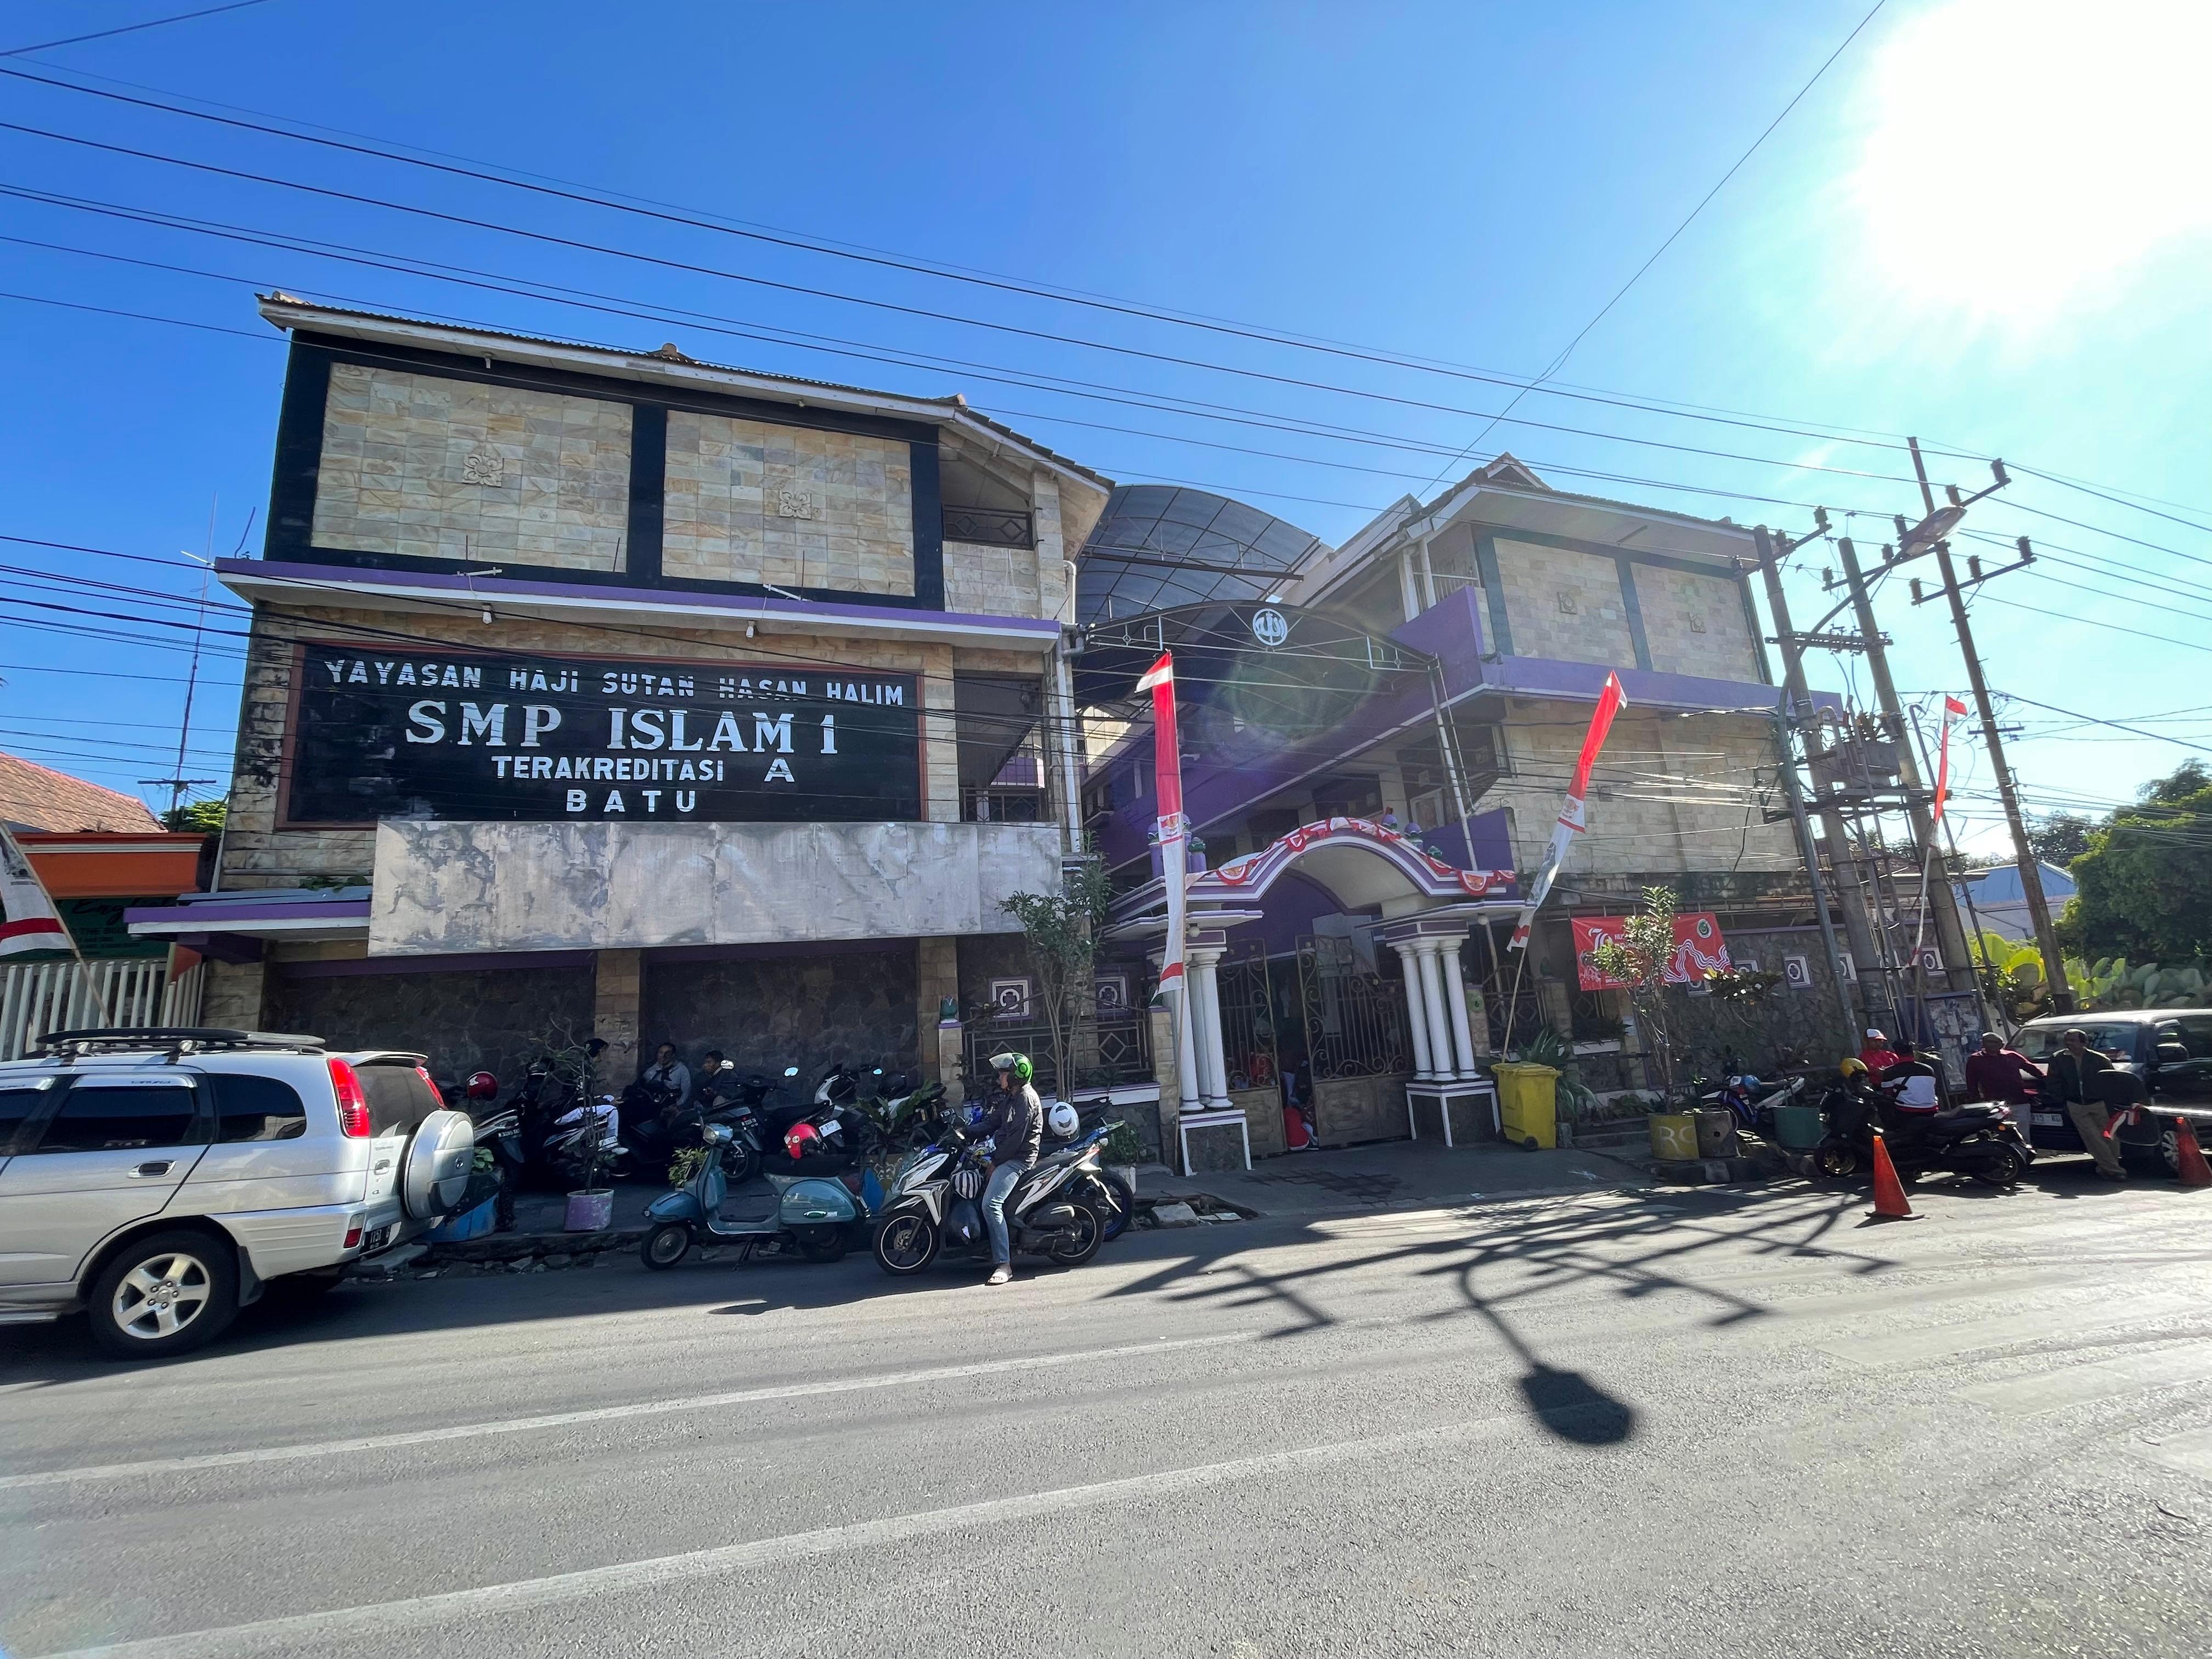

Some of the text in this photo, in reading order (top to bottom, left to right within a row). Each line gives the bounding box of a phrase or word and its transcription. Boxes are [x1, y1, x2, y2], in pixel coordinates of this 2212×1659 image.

[324, 659, 903, 706] YAYASAN HAJI SUTAN HASAN HALIM
[405, 699, 838, 754] SMP ISLAM 1
[491, 755, 795, 783] TERAKREDITASI A
[566, 789, 696, 812] BATU
